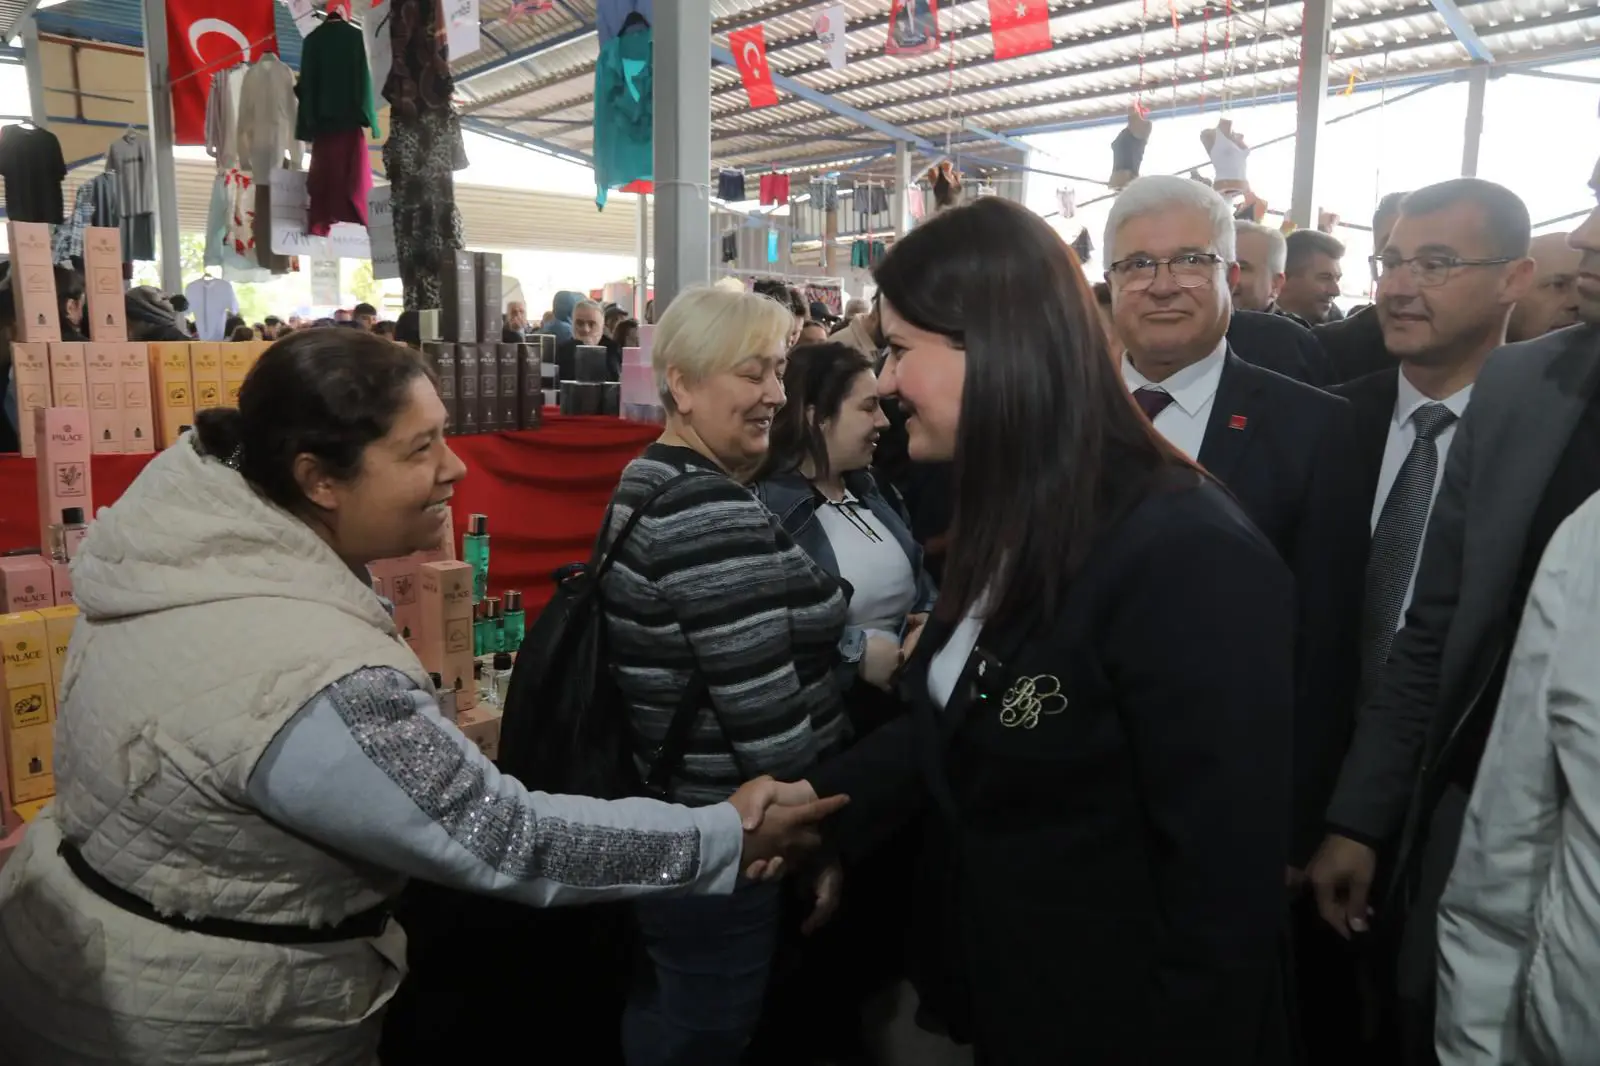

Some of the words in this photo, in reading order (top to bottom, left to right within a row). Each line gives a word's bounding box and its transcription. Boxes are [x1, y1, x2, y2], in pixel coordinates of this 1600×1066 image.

[52, 433, 84, 442] PALACE
[13, 592, 48, 603] PALACE
[2, 650, 43, 664] PALACE
